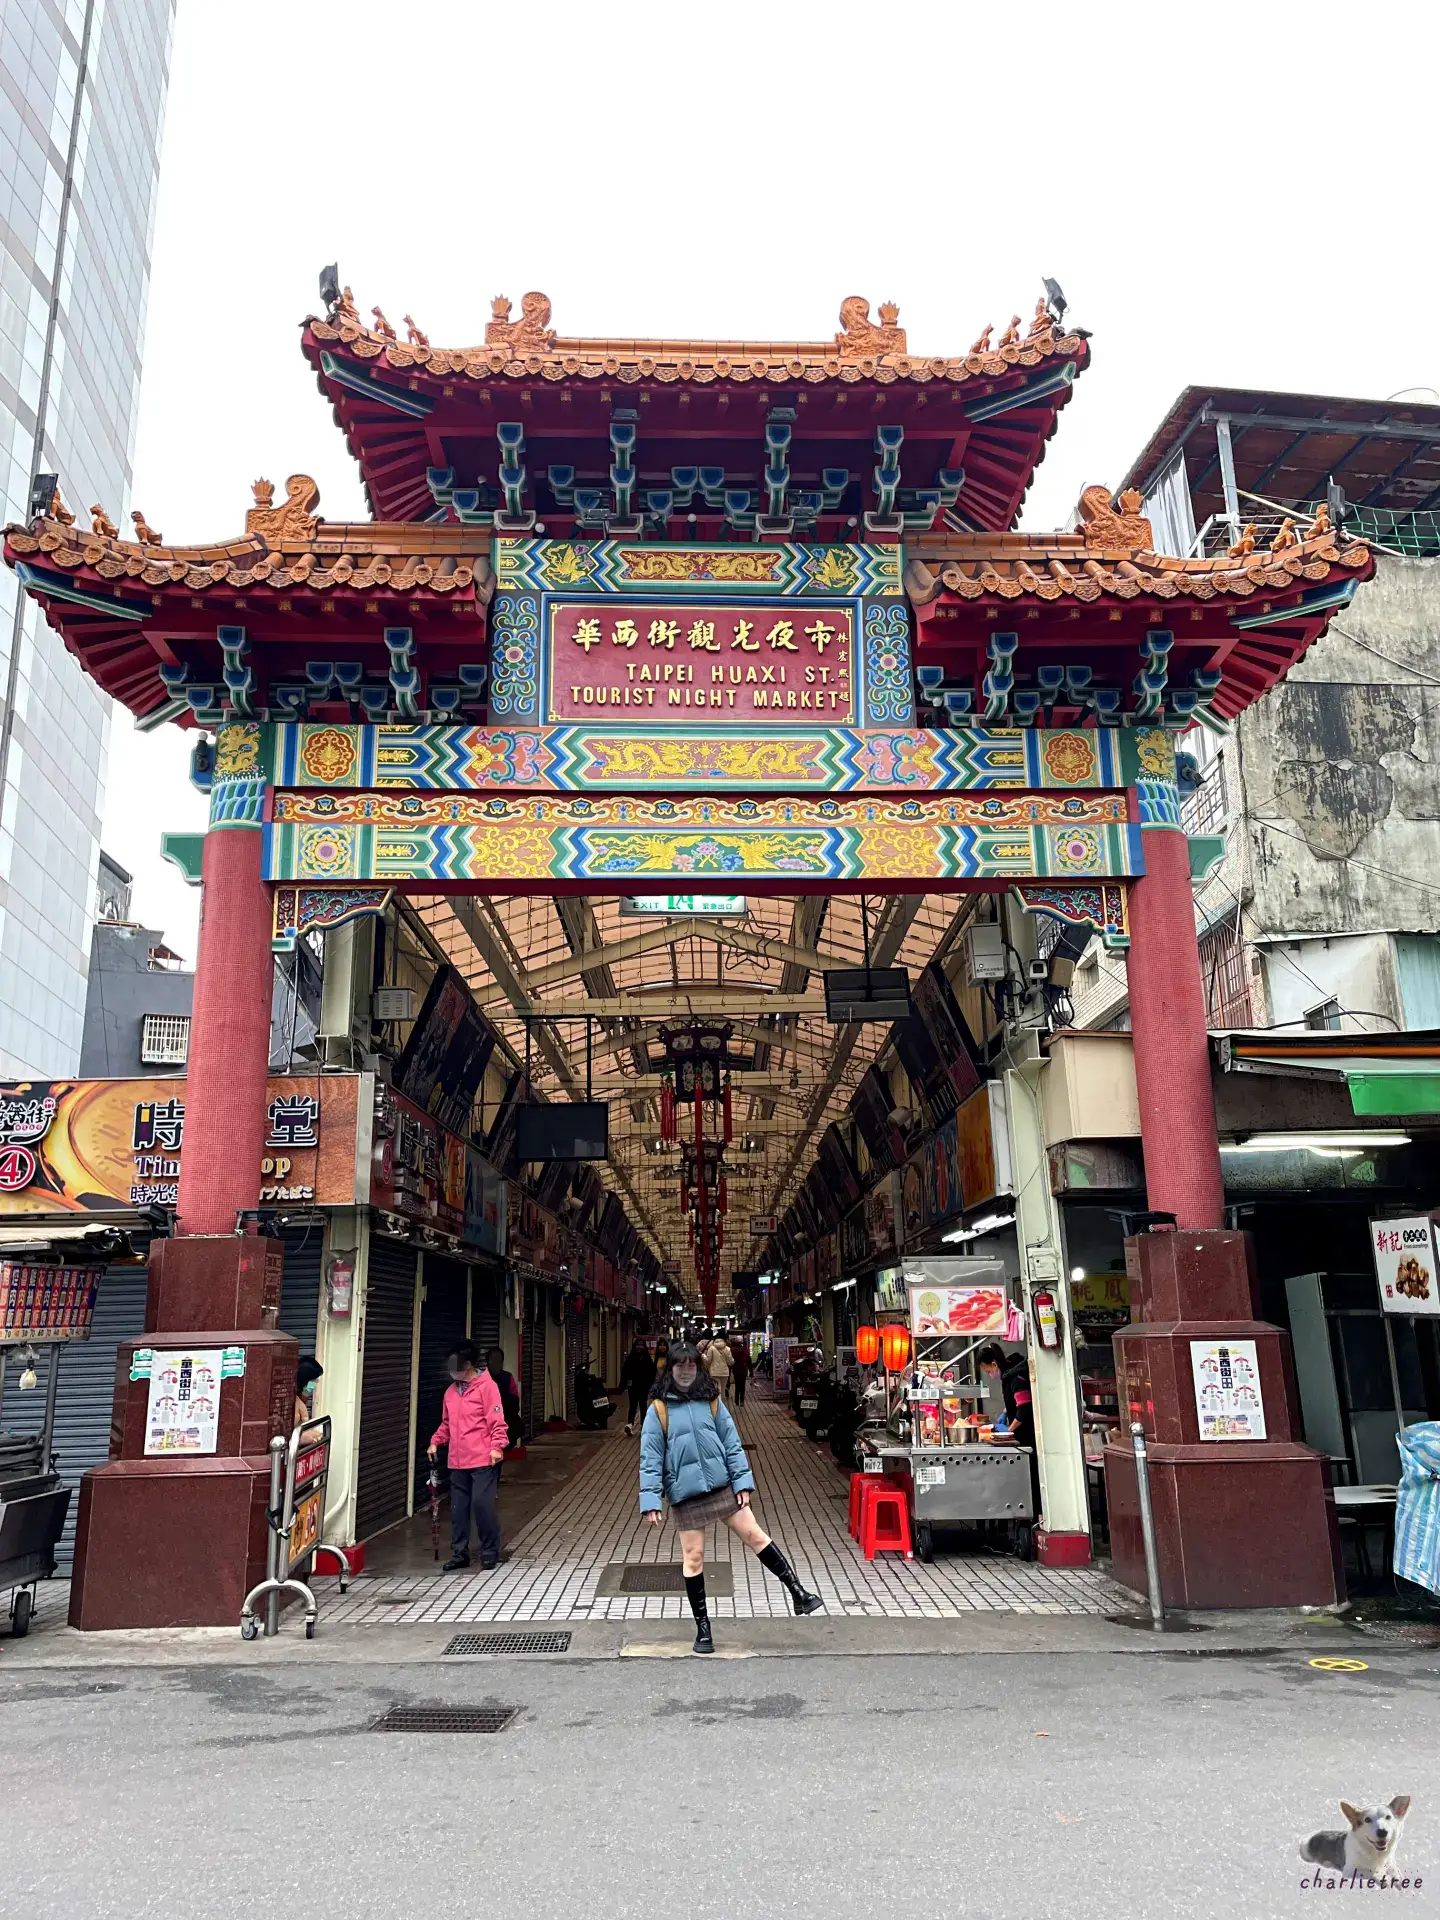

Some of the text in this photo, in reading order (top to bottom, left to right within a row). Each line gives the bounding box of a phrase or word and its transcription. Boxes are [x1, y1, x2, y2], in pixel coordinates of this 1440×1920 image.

[571, 618, 836, 654] 華西街觀光夜市
[627, 663, 835, 684] TAIPEI HUAXI ST.
[570, 686, 839, 709] TOURIST NIGHT MARKET
